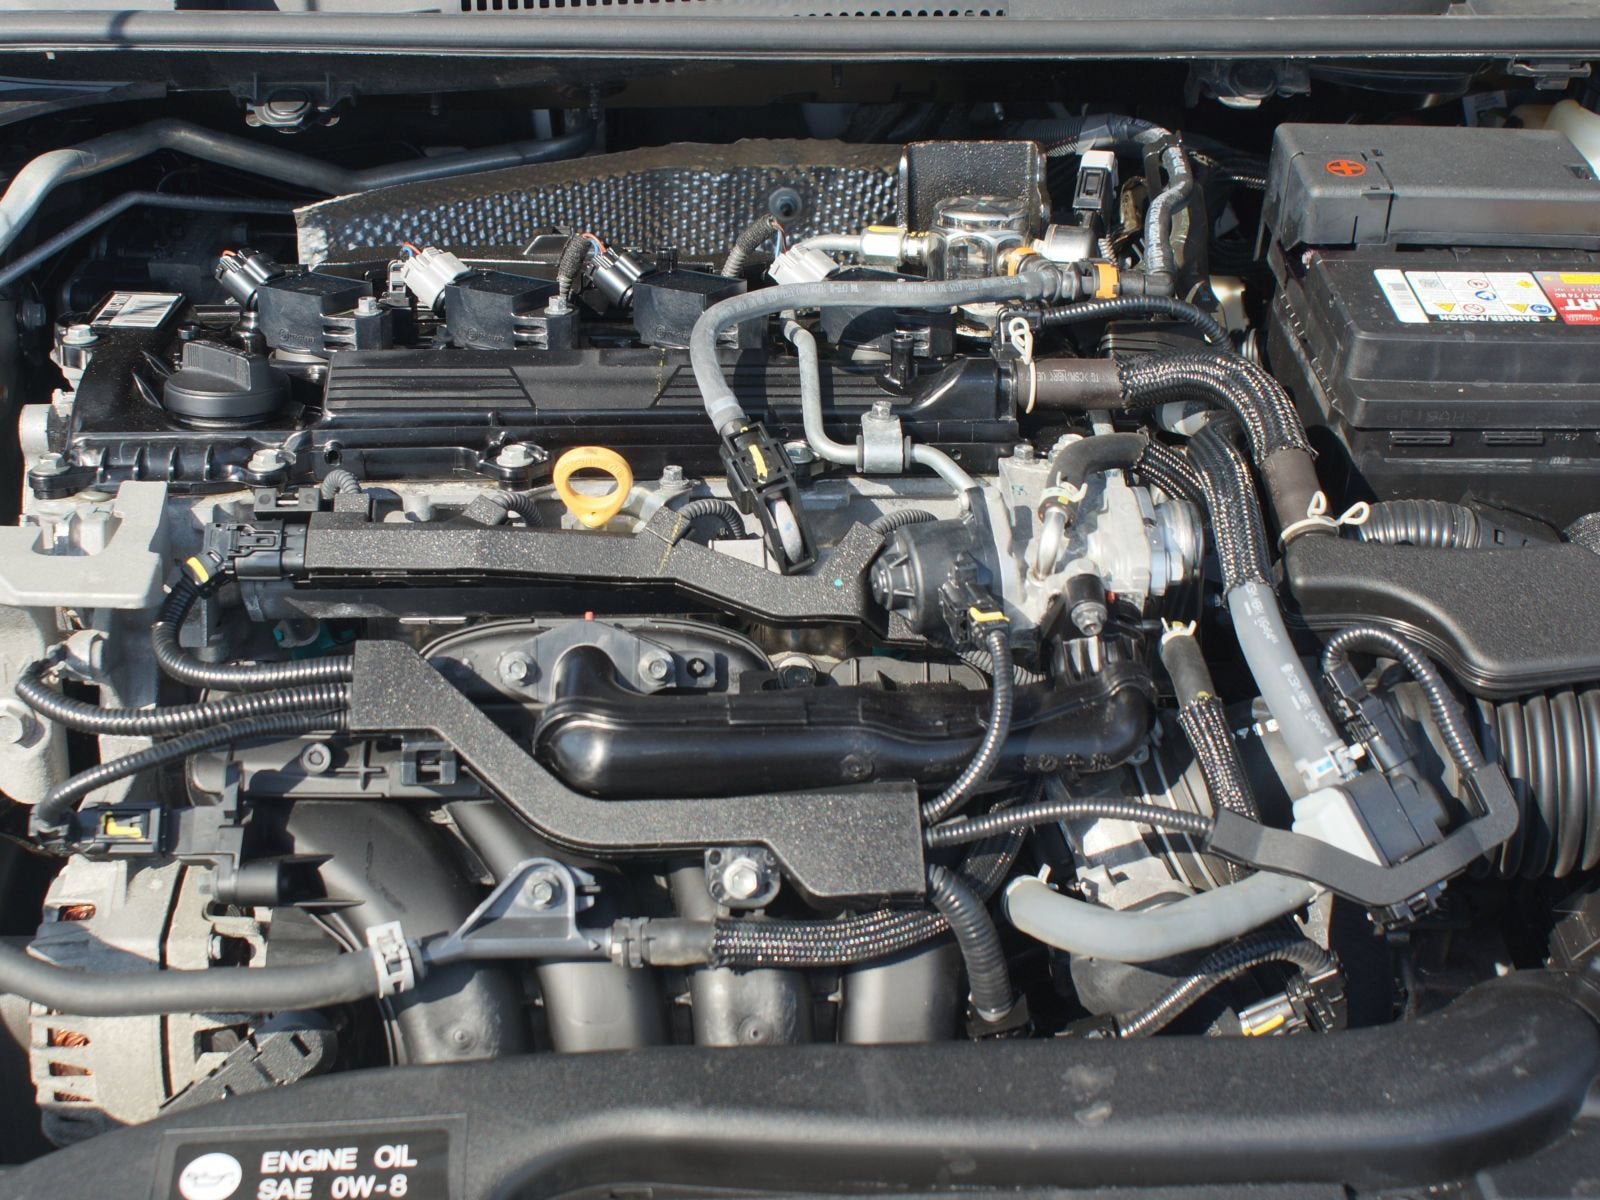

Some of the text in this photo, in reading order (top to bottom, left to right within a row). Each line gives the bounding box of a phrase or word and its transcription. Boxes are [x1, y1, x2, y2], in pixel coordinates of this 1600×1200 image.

[1439, 313, 1541, 322] DANGER/POISON
[260, 1144, 418, 1174] ENGINE OIL
[257, 1174, 408, 1200] SAE 0W-8
